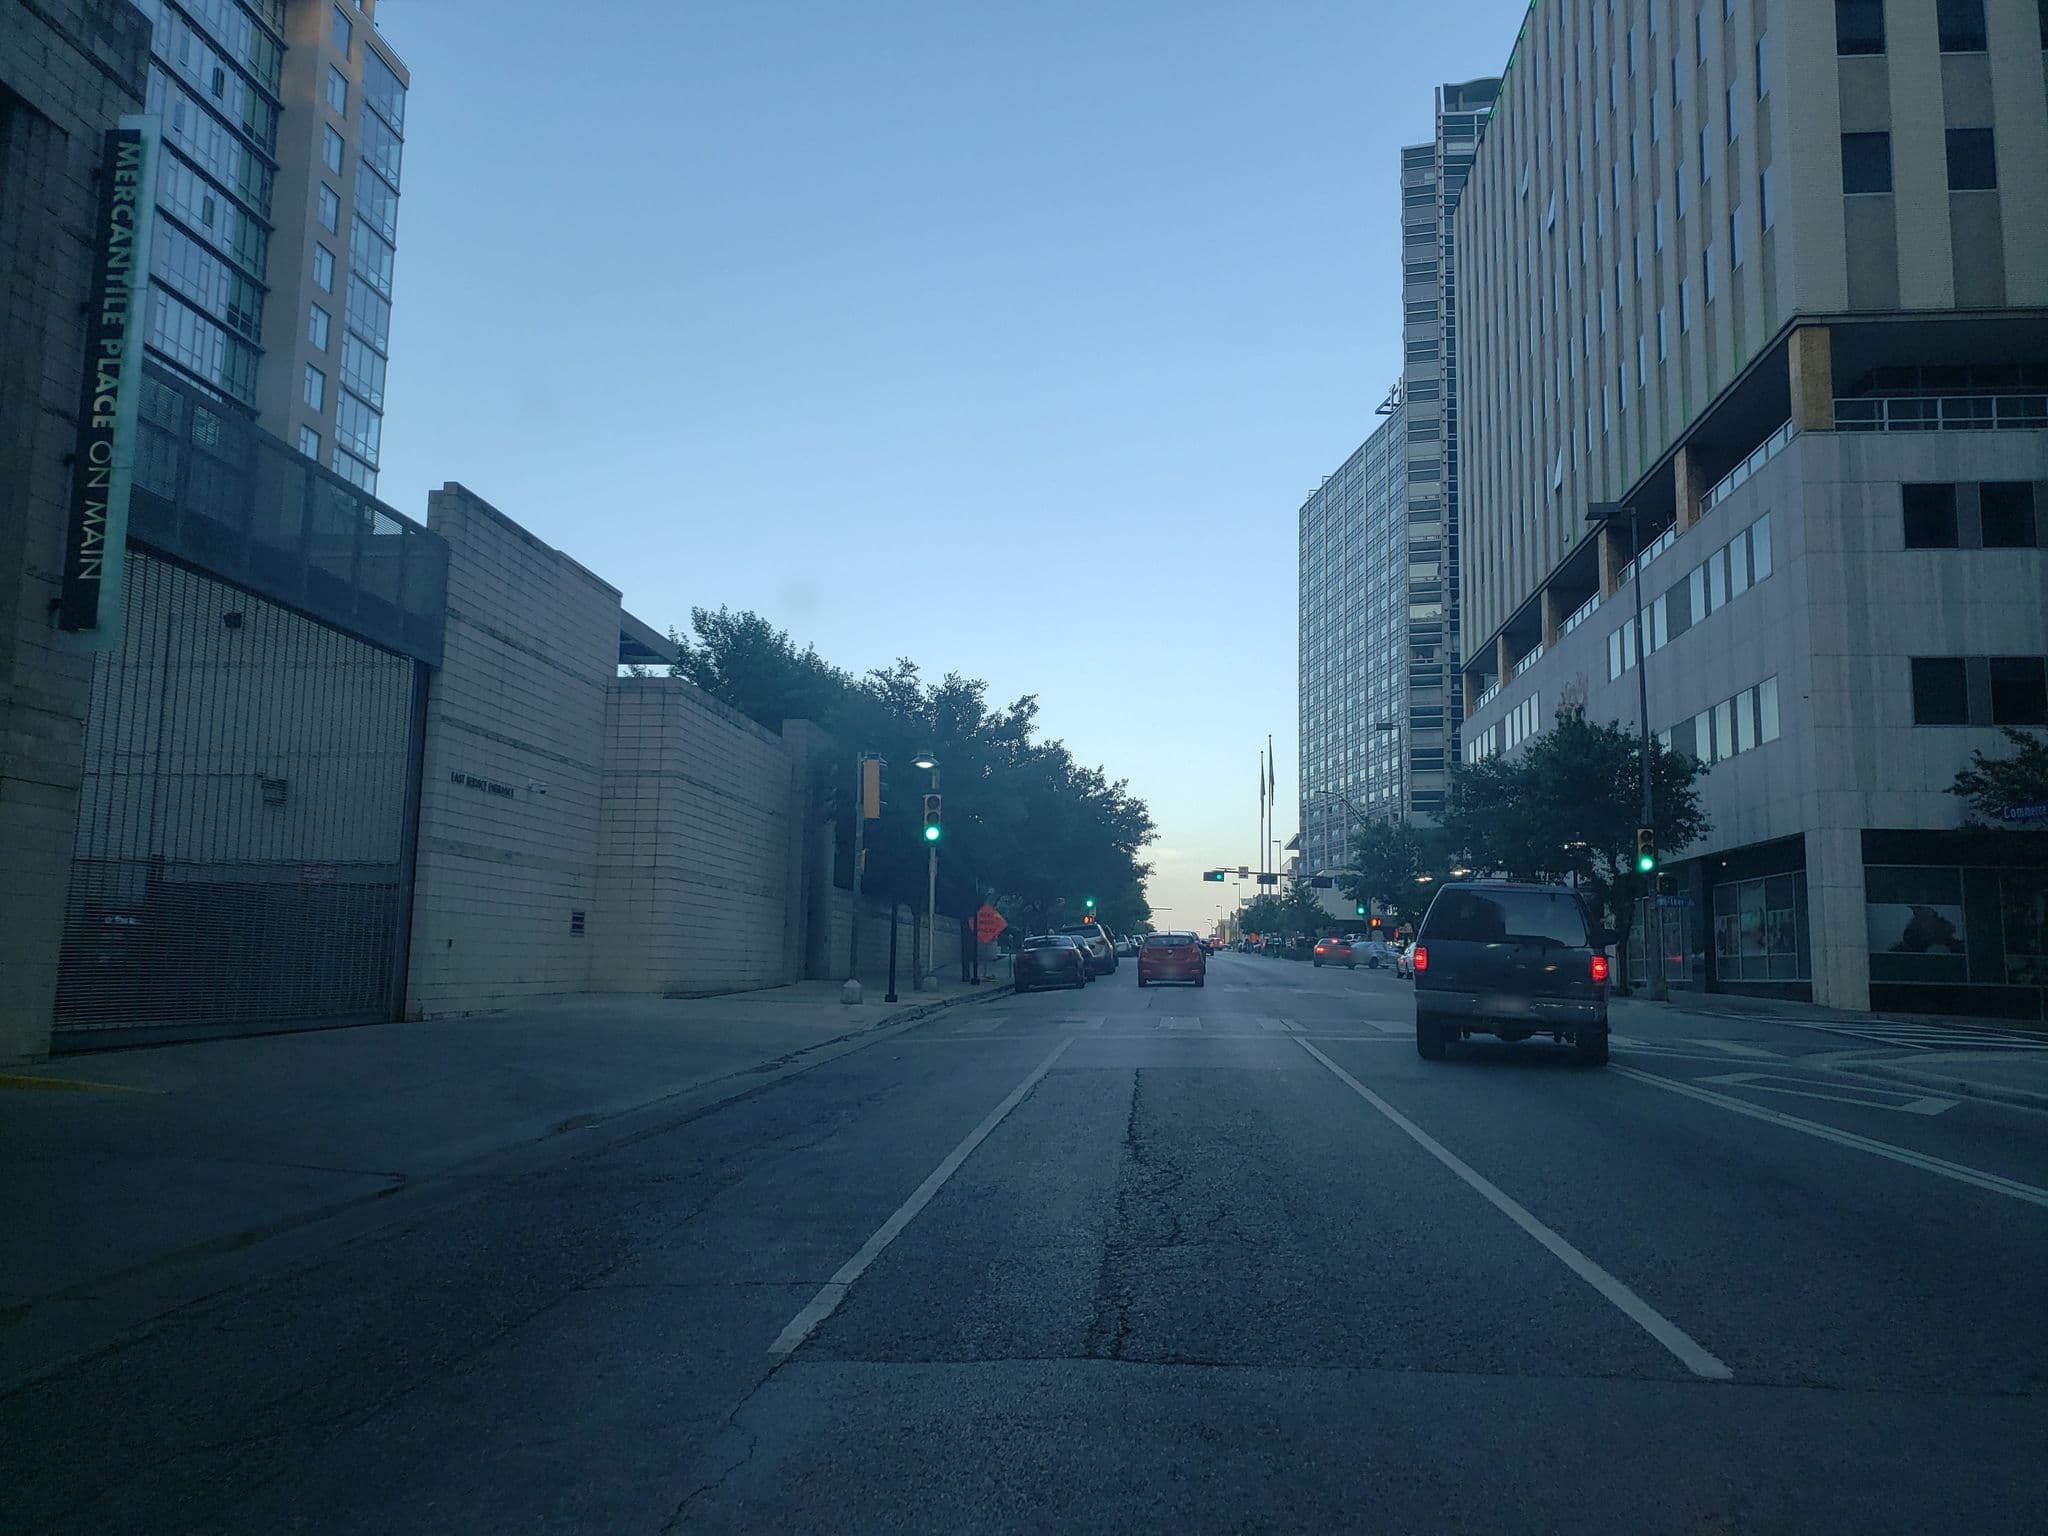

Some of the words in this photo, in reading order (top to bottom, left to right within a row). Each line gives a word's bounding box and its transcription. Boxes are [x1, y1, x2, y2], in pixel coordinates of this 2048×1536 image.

[102, 141, 141, 326] MERCANTILE
[92, 338, 122, 429] PLACE
[87, 440, 112, 488] ON
[79, 500, 107, 580] MAIN
[450, 771, 466, 784] EAST
[2004, 805, 2047, 818] Commerce
